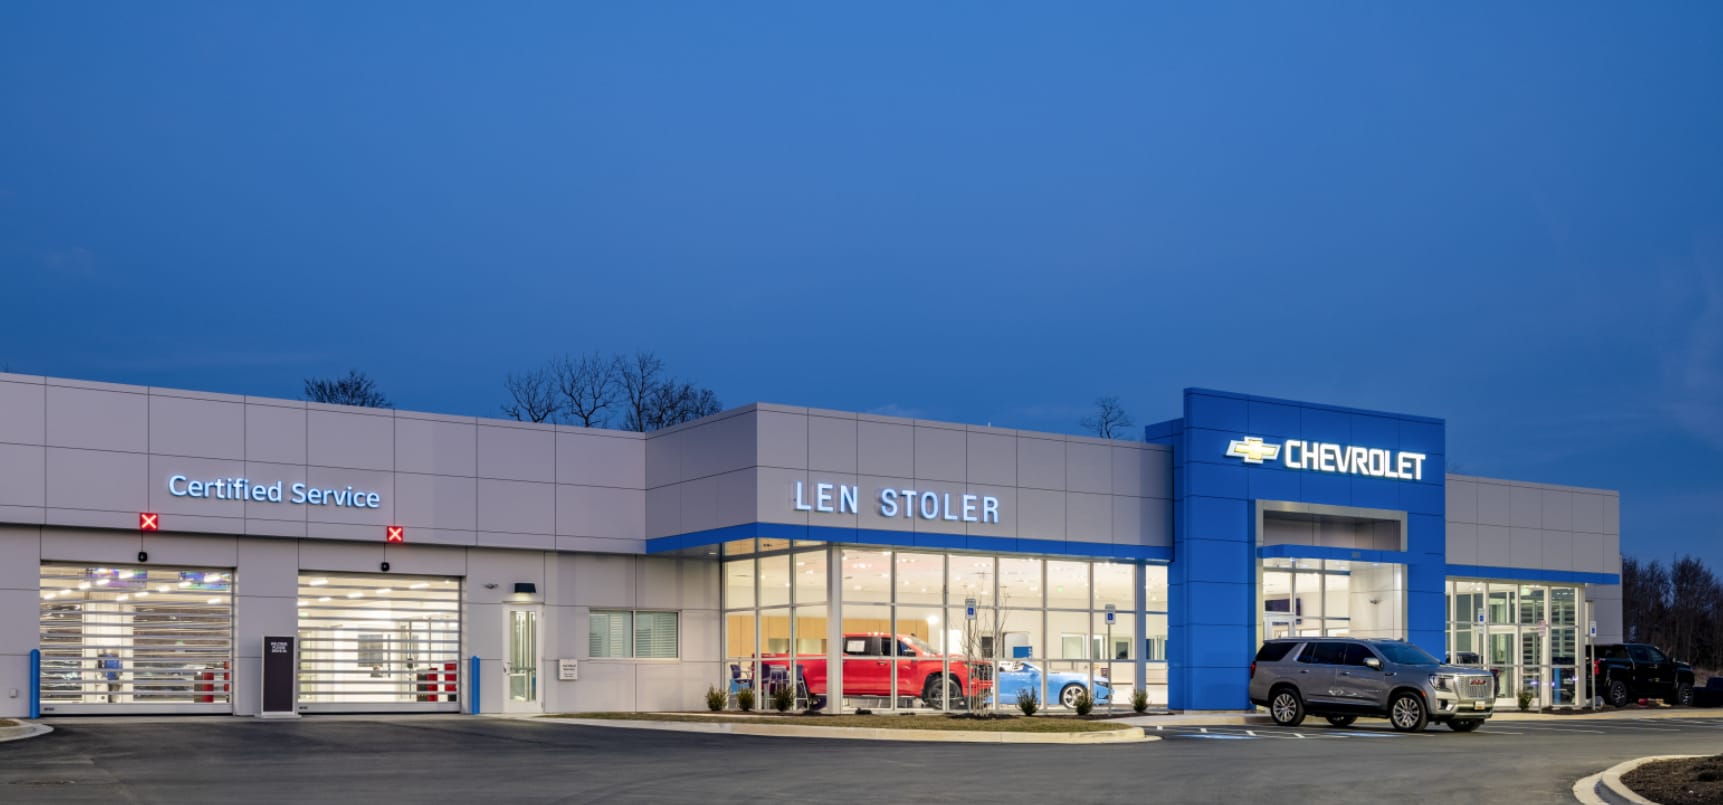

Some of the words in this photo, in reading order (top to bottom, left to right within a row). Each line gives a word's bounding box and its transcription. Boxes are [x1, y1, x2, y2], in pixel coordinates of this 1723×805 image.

[1285, 439, 1427, 481] CHEVROLET
[168, 474, 283, 503] Certified
[290, 482, 381, 509] Service
[795, 481, 859, 515] LEN
[880, 488, 1000, 524] STOLER
